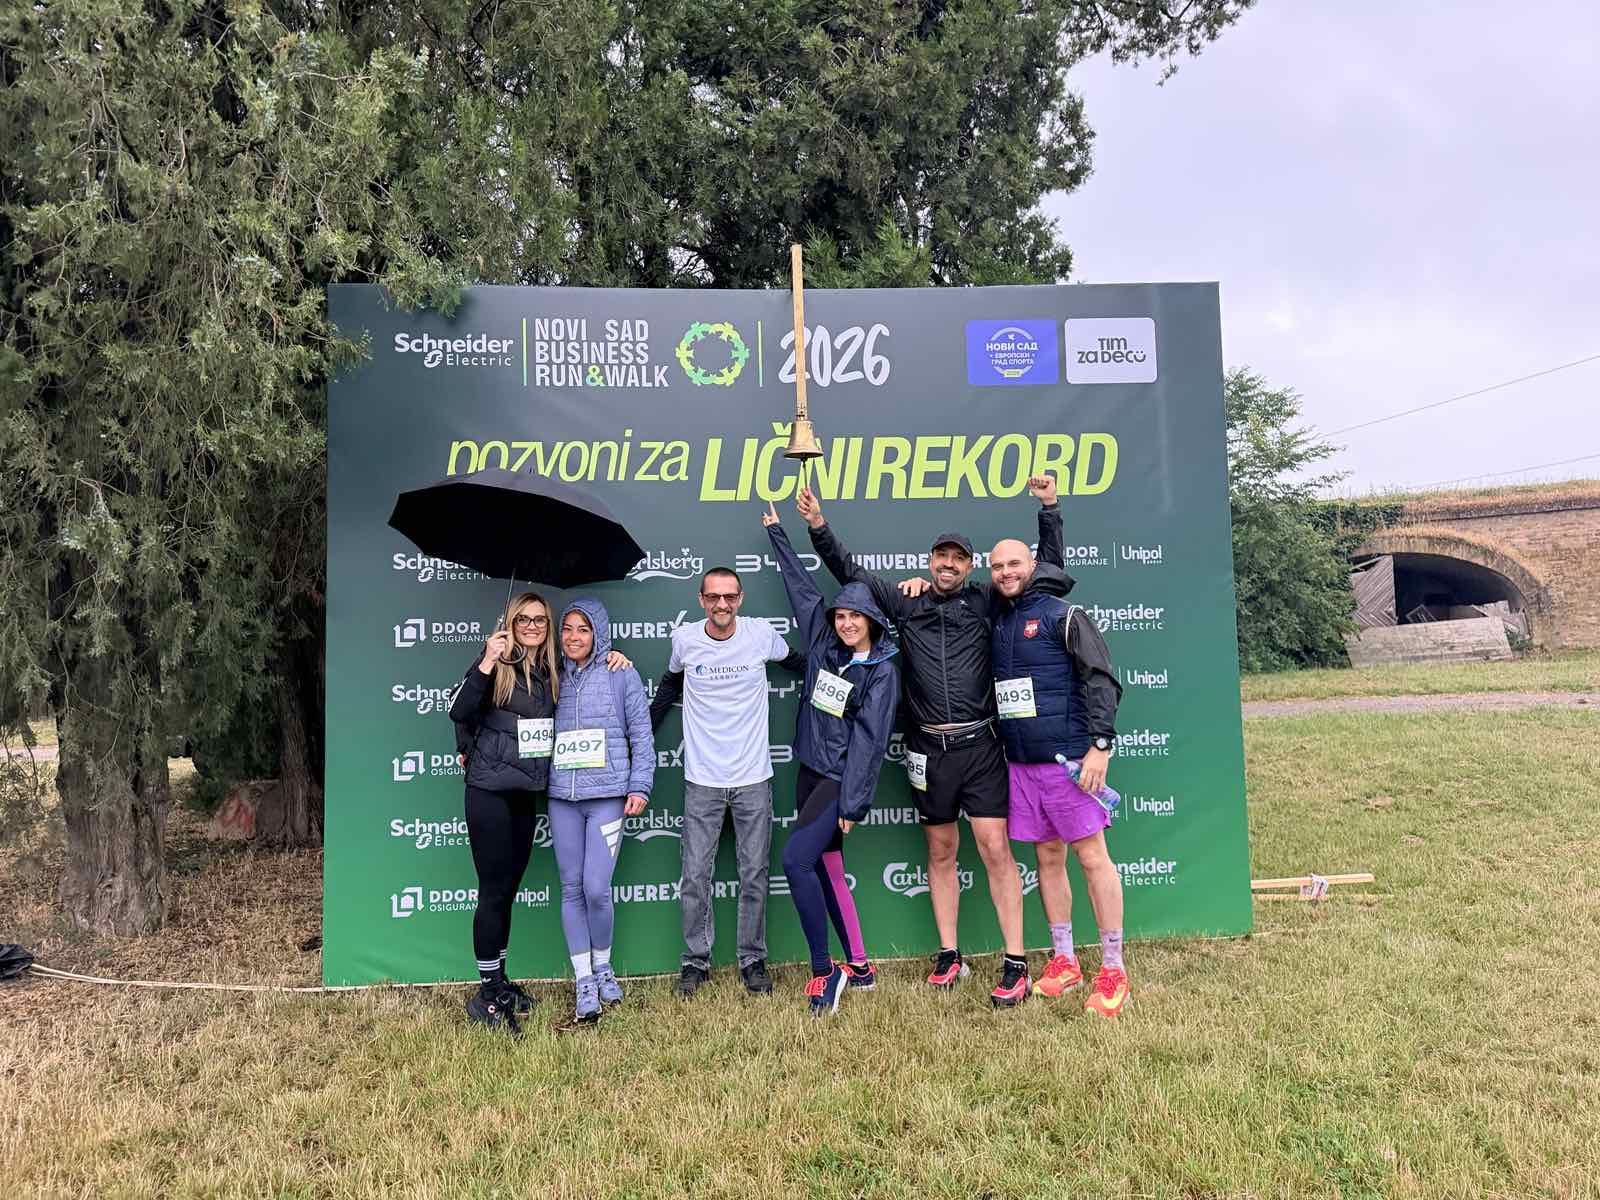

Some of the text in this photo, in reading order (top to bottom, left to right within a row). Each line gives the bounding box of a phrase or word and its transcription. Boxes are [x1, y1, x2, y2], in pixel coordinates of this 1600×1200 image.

[535, 318, 649, 342] NOVI SAD
[394, 332, 514, 353] Schneider
[986, 341, 1039, 352] НОВИ САД
[446, 354, 512, 366] Electric
[535, 341, 649, 364] BUSINESS
[778, 323, 891, 388] 2026
[535, 364, 669, 387] RUN&WALK
[634, 440, 690, 481] za
[699, 422, 863, 501] LIČNI
[865, 432, 1119, 499] REKORD
[1064, 546, 1098, 558] DOR
[1121, 545, 1162, 564] Unipol
[627, 548, 704, 581] rlsberg
[437, 569, 491, 581] Electri
[432, 621, 481, 634] DDOR
[1112, 620, 1164, 631] Electric
[709, 664, 749, 674] MEDICON
[1127, 669, 1168, 688] Unipol
[816, 679, 846, 702] 0496
[996, 689, 1032, 705] 0493
[1115, 729, 1170, 746] neider
[557, 739, 602, 755] 0497
[1118, 746, 1169, 757] Electric
[907, 760, 924, 776] 95
[1133, 796, 1174, 816] Unipol
[1116, 857, 1176, 874] neider
[1124, 874, 1176, 886] Electric
[430, 889, 479, 903] DDOR
[515, 885, 550, 907] nipol
[429, 903, 478, 912] OSIGURAN
